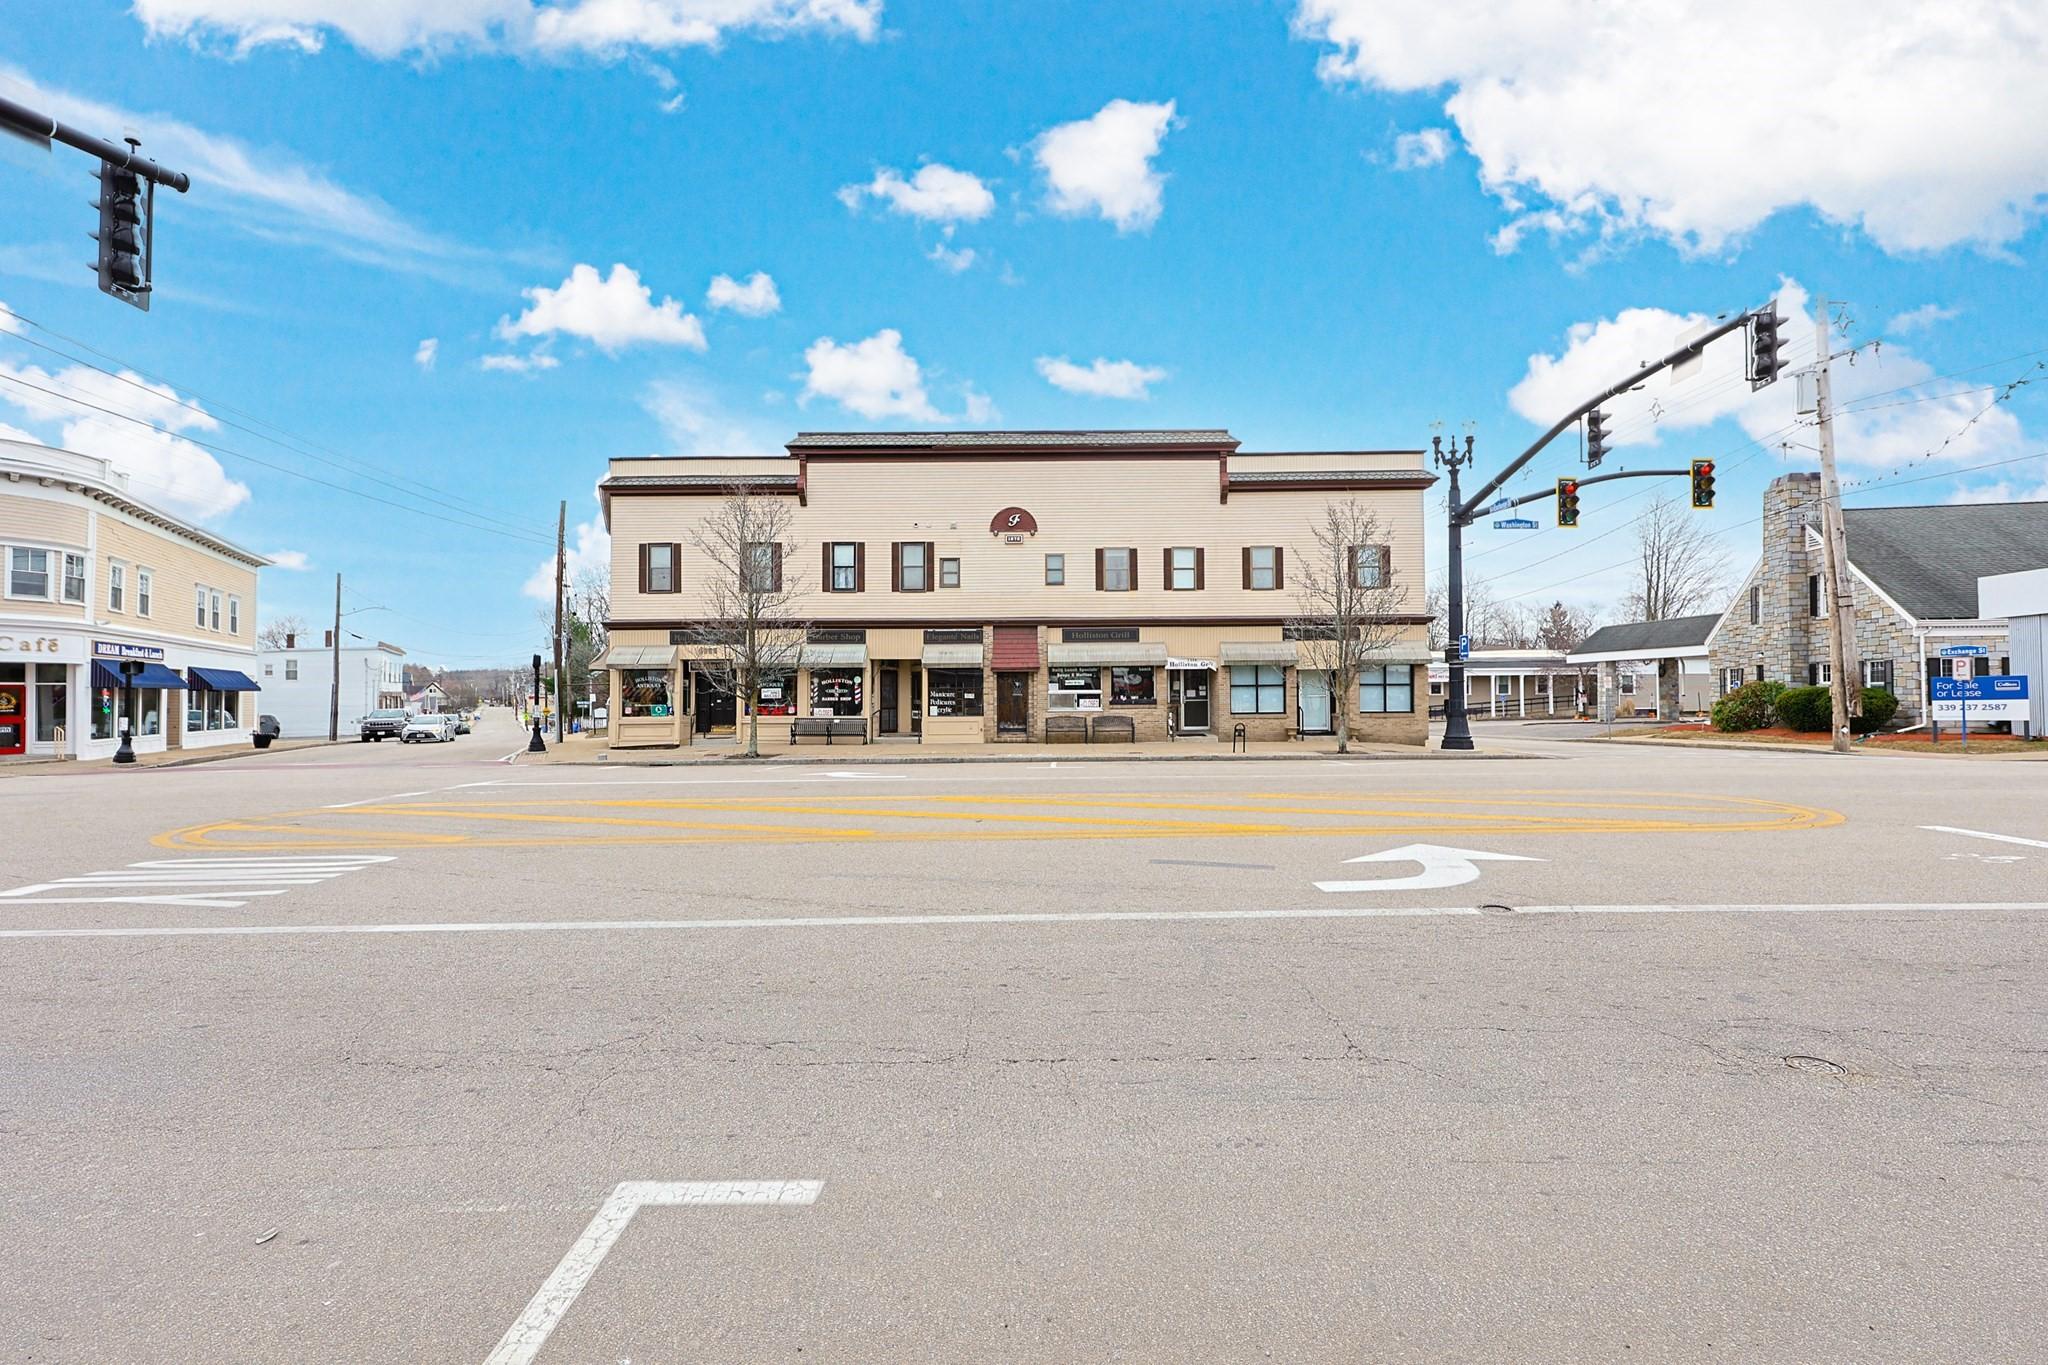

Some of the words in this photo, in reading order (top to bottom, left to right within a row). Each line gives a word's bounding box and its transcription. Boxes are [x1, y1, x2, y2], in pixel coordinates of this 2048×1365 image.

[1501, 521, 1531, 529] Washington
[839, 632, 861, 642] Shop
[960, 631, 980, 641] Nails
[1072, 631, 1108, 639] Holliston
[1111, 631, 1130, 639] Grill
[0, 636, 59, 652] Café
[1461, 638, 1467, 650] P
[97, 643, 120, 655] DREAM
[121, 646, 144, 658] Breakfast
[145, 649, 149, 657] &
[149, 649, 162, 659] Lunch
[1947, 648, 1976, 656] Exchange
[1956, 660, 1967, 672] P
[1936, 682, 1953, 690] For
[1956, 681, 1979, 690] Sale
[1951, 689, 1982, 697] Lease
[1981, 703, 2007, 711] 2587
